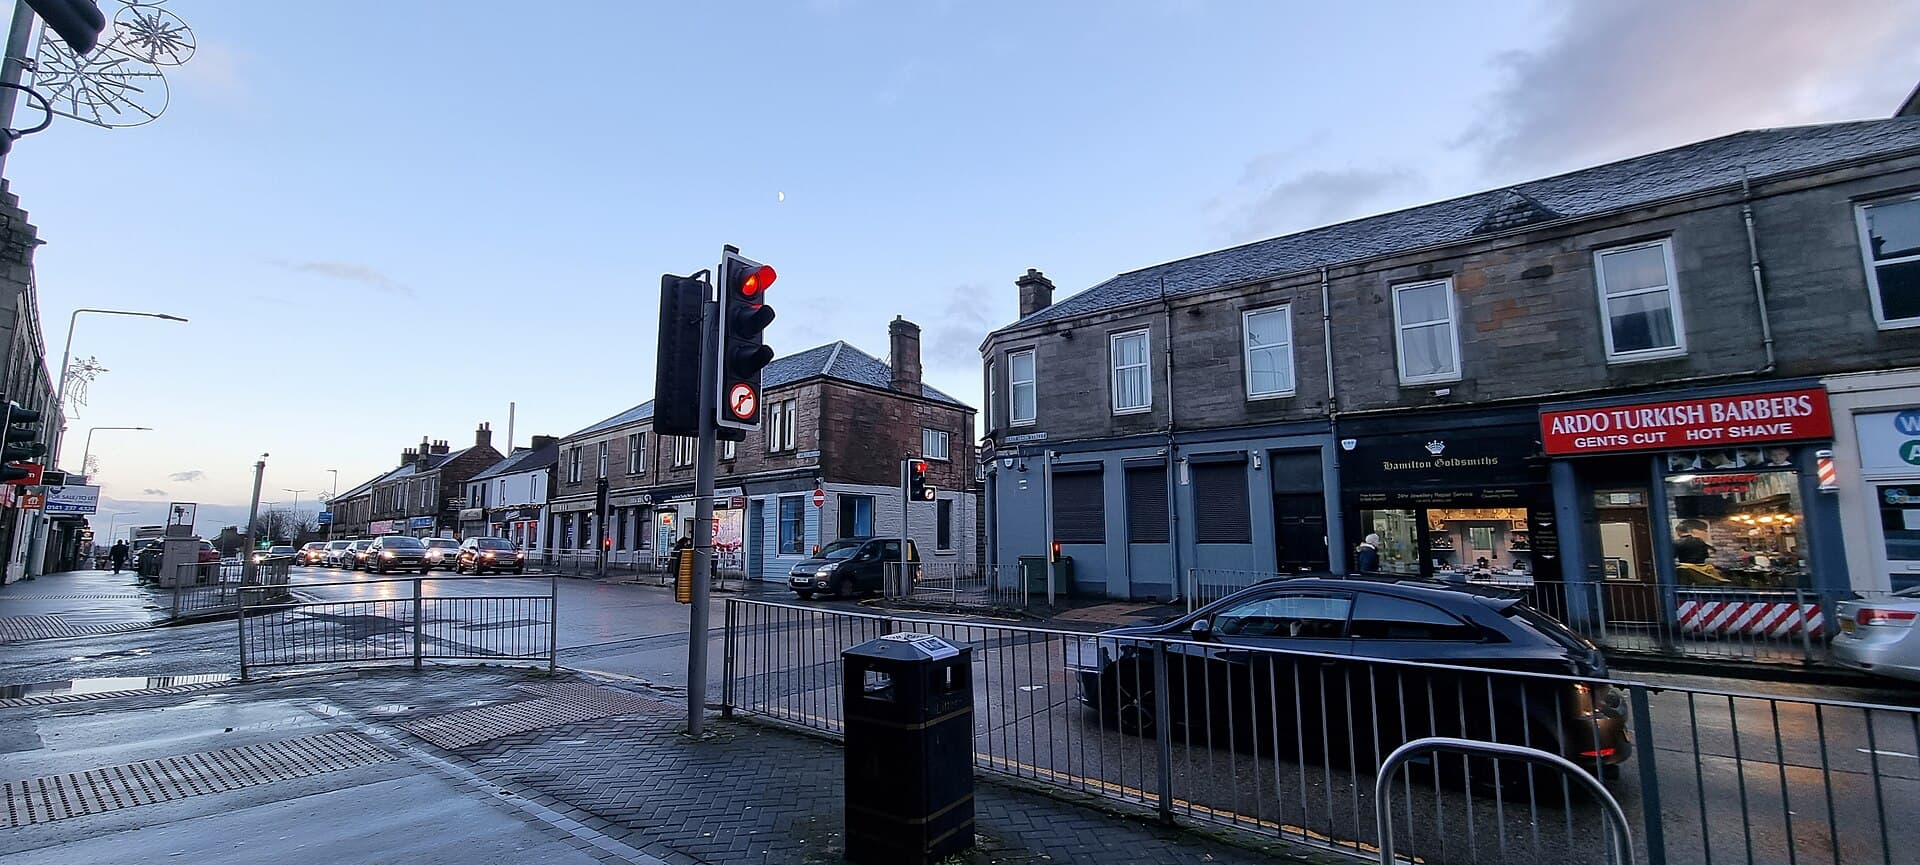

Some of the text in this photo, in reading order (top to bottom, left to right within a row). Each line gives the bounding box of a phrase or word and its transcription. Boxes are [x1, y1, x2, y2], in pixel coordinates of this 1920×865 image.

[1551, 395, 1813, 435] ARDO TURKISH BARBERS
[1574, 431, 1667, 448] GENTS CUT
[1686, 422, 1793, 440] HOT SHAVE
[1383, 456, 1499, 471] Hamilton Goldsmiths
